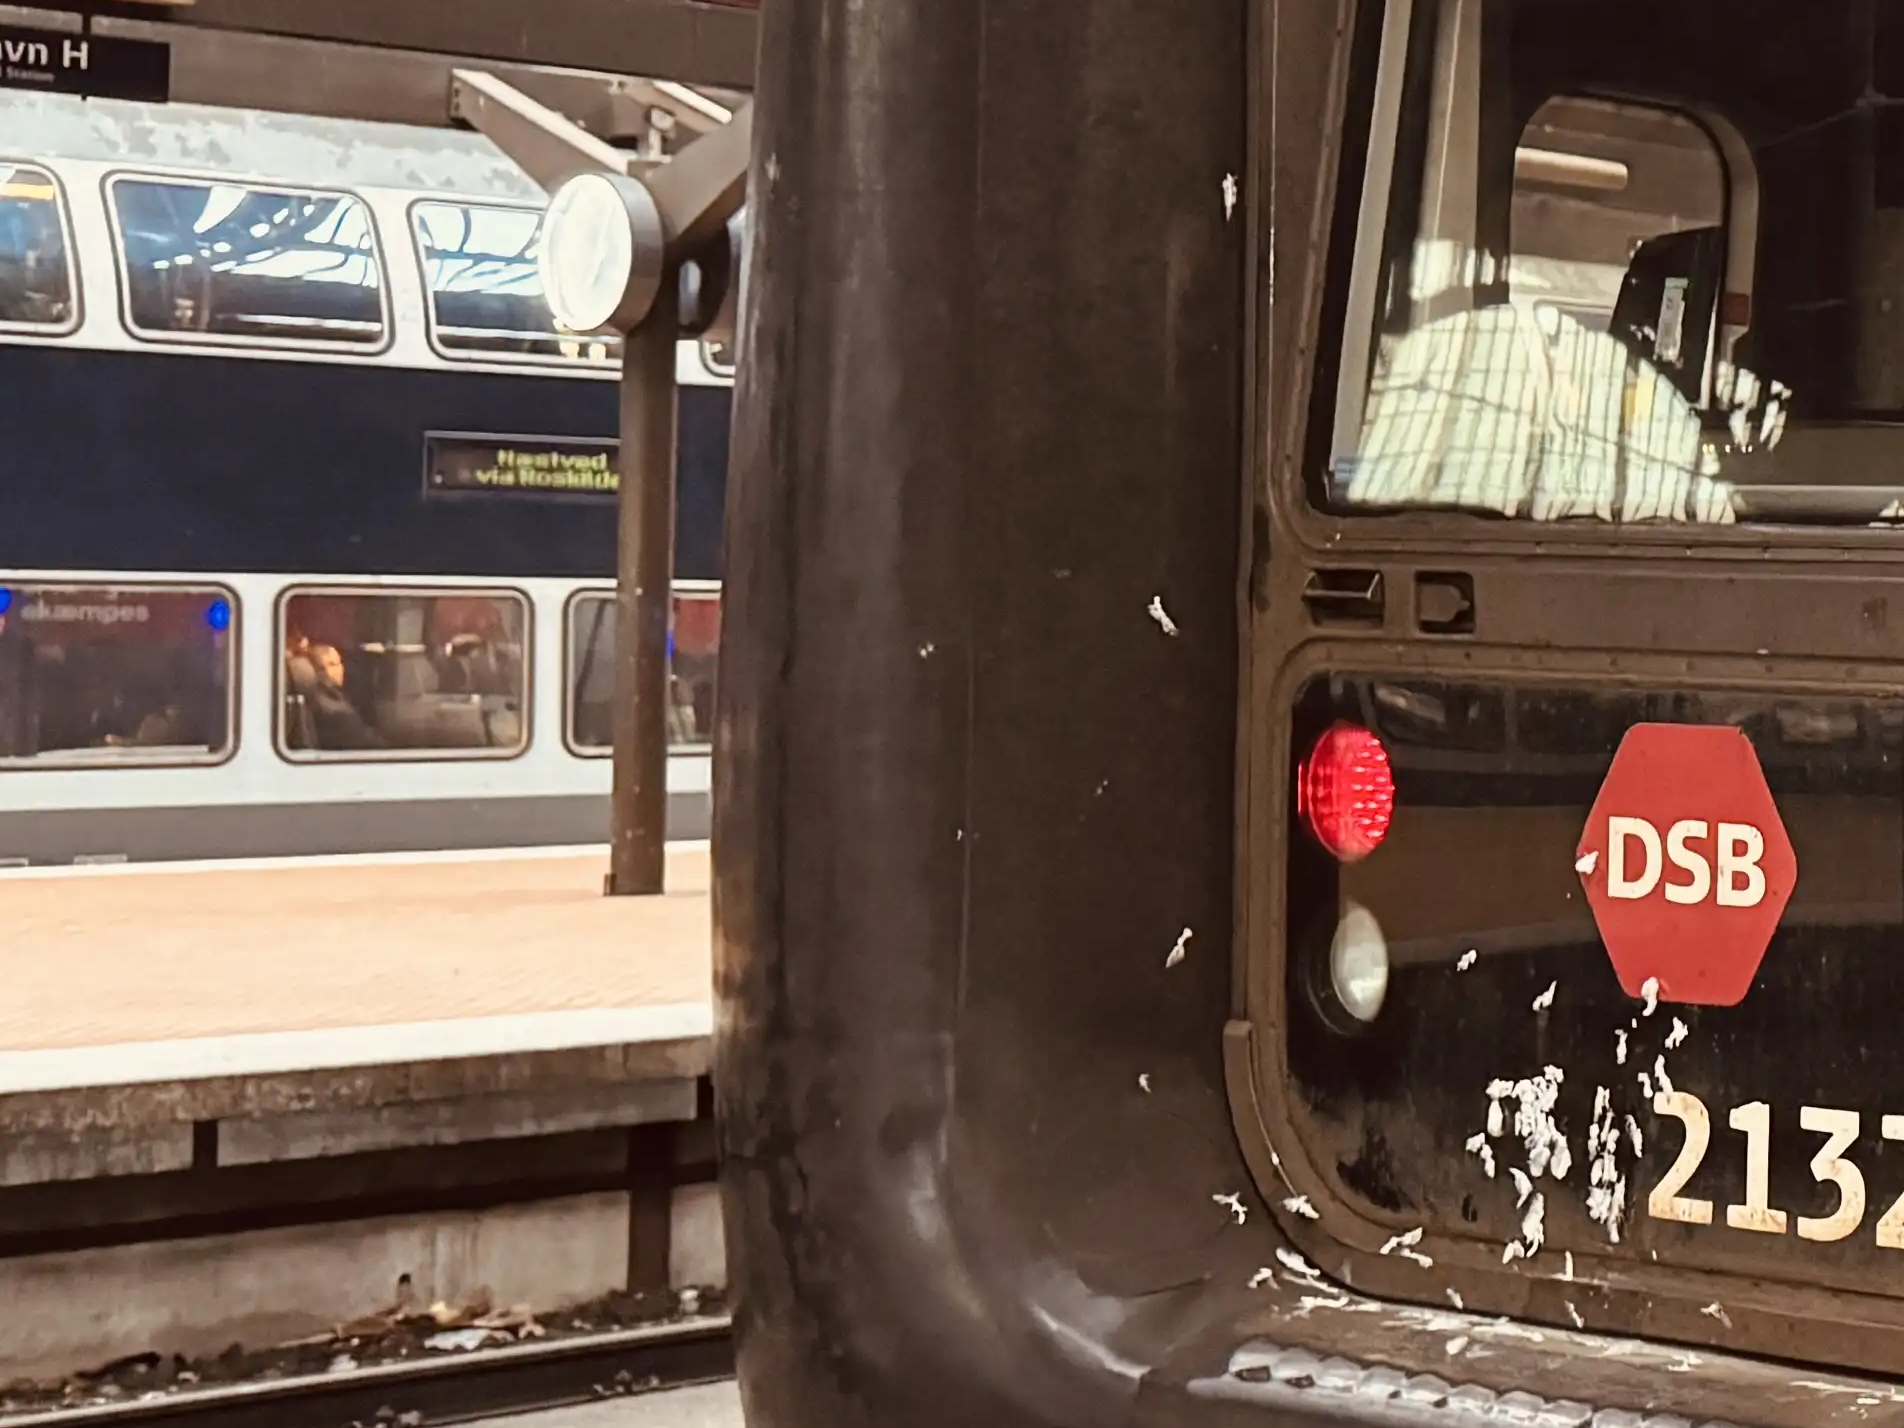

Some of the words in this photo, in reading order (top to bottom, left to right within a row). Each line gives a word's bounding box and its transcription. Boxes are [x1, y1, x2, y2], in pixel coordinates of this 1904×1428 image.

[0, 39, 49, 65] vn
[62, 39, 89, 70] H
[1608, 815, 1766, 907] DSB
